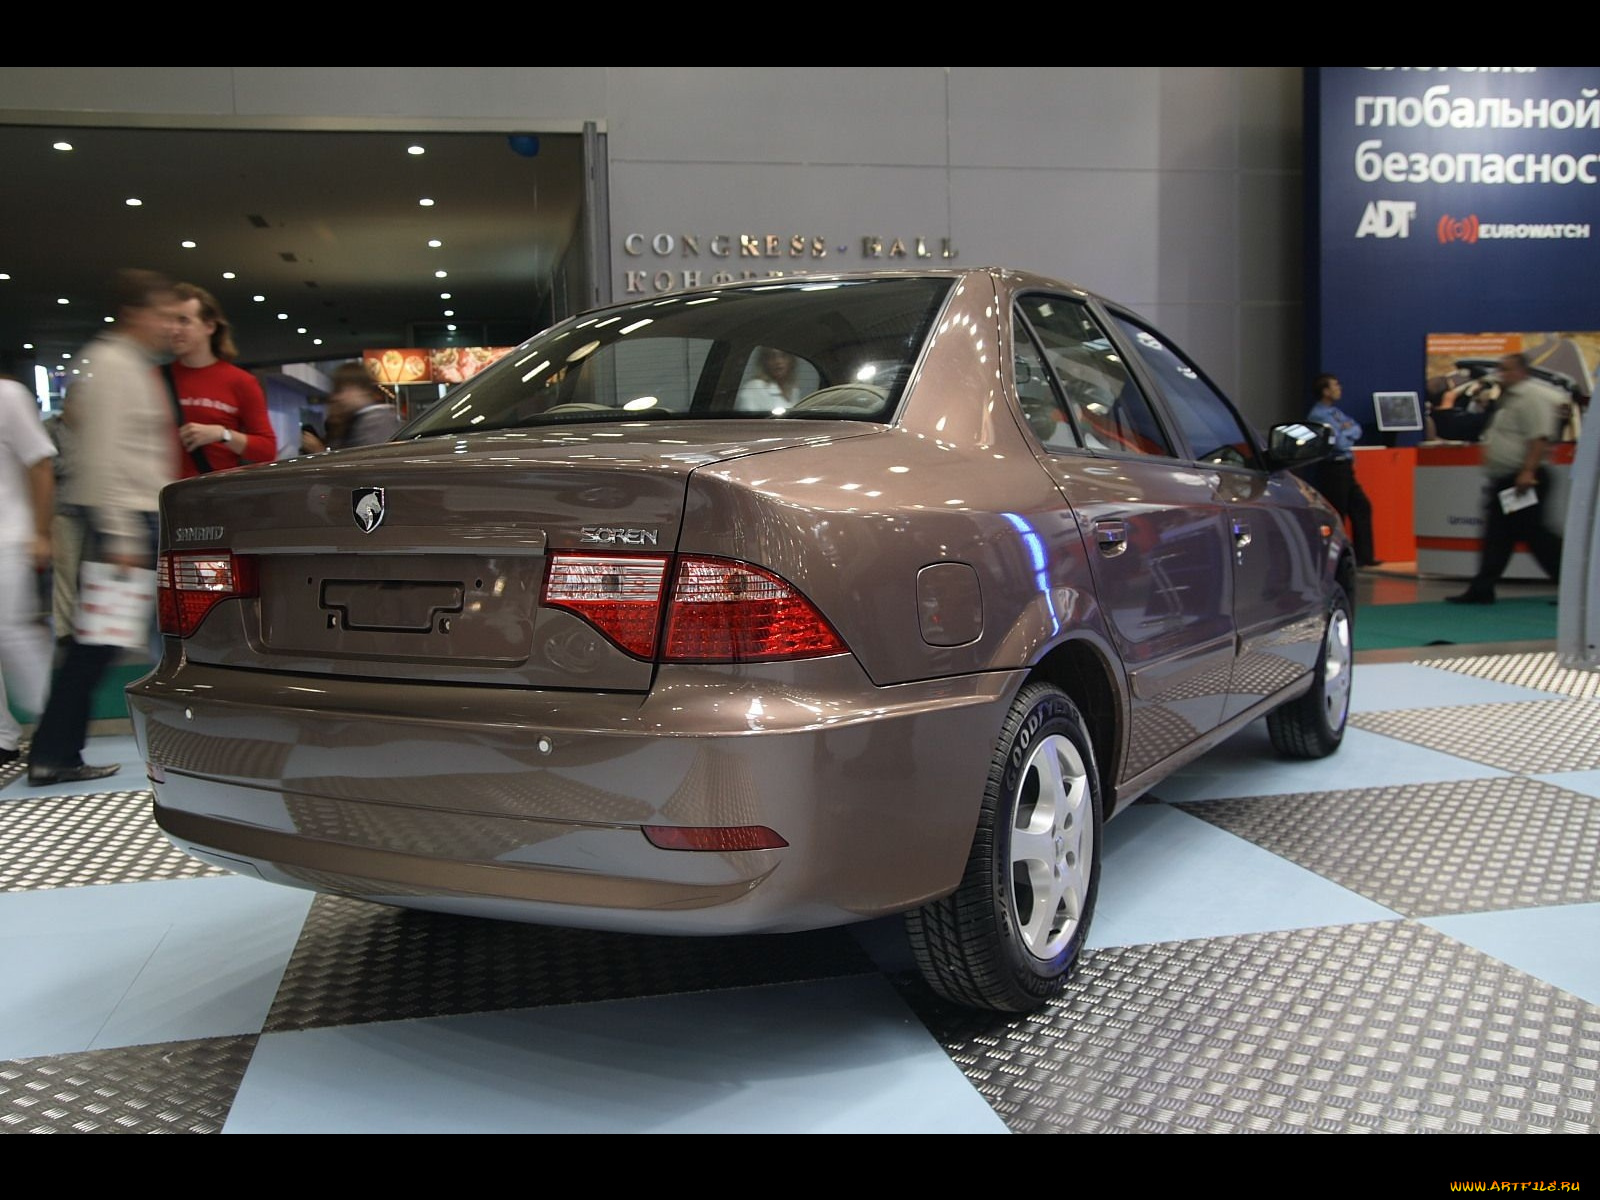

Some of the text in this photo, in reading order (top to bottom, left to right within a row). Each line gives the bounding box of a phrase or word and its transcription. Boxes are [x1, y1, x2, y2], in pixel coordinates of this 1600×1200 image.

[1354, 84, 1600, 129] глобальной
[1354, 139, 1600, 185] безопаснос
[1355, 200, 1417, 238] ADT
[1478, 223, 1590, 239] EUROWATCH
[624, 233, 959, 258] CONGRESS HALL
[175, 525, 224, 542] SAMAND
[580, 527, 658, 545] SOREN
